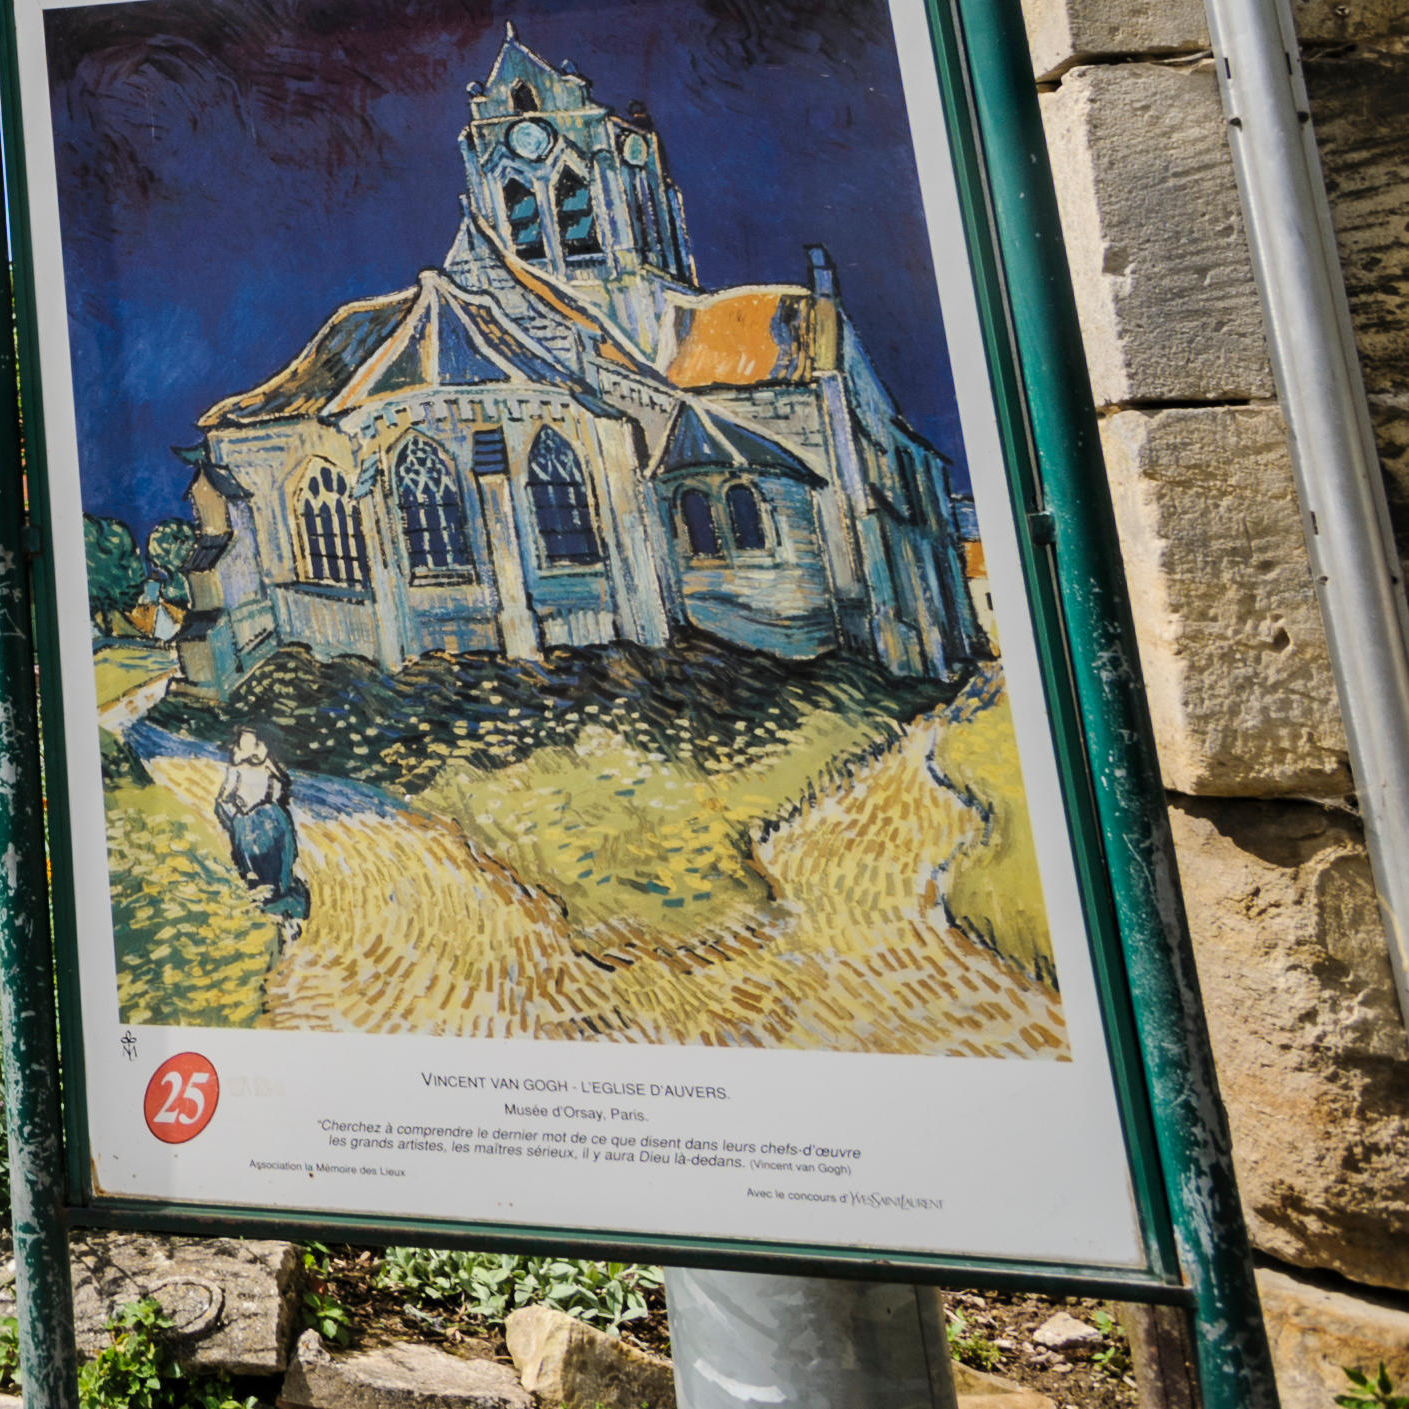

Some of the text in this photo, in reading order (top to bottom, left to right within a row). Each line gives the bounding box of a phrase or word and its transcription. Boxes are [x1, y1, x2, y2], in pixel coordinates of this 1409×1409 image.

[153, 1071, 210, 1125] 25
[421, 1072, 486, 1088] VINCENT
[490, 1078, 519, 1090] VAN
[523, 1079, 568, 1092] GOGH
[581, 1082, 646, 1095] L'EGLISE
[650, 1084, 730, 1099] D'AUVERS.
[505, 1104, 648, 1122] Musée d'Orsay, Paris.
[385, 1123, 393, 1134] à
[397, 1126, 473, 1138] comprendre
[477, 1128, 489, 1138] le
[492, 1128, 538, 1141] dernier
[542, 1132, 566, 1143] mot
[570, 1132, 587, 1144] de
[591, 1136, 607, 1144] ce
[611, 1136, 636, 1148] que
[640, 1136, 683, 1149] disent
[685, 1138, 718, 1151] dans
[723, 1140, 756, 1153] leurs
[760, 1142, 861, 1159] chefs-d'œuvre
[250, 1160, 405, 1176] Association la Mémoire des Lieux
[329, 1135, 851, 1176] les grands artistes, les maîtres sérieux, il y aura Dieu là-dedans. (Vincent van Gogh)
[747, 1188, 772, 1198] Avec
[775, 1191, 784, 1199] le
[788, 1193, 837, 1202] concours
